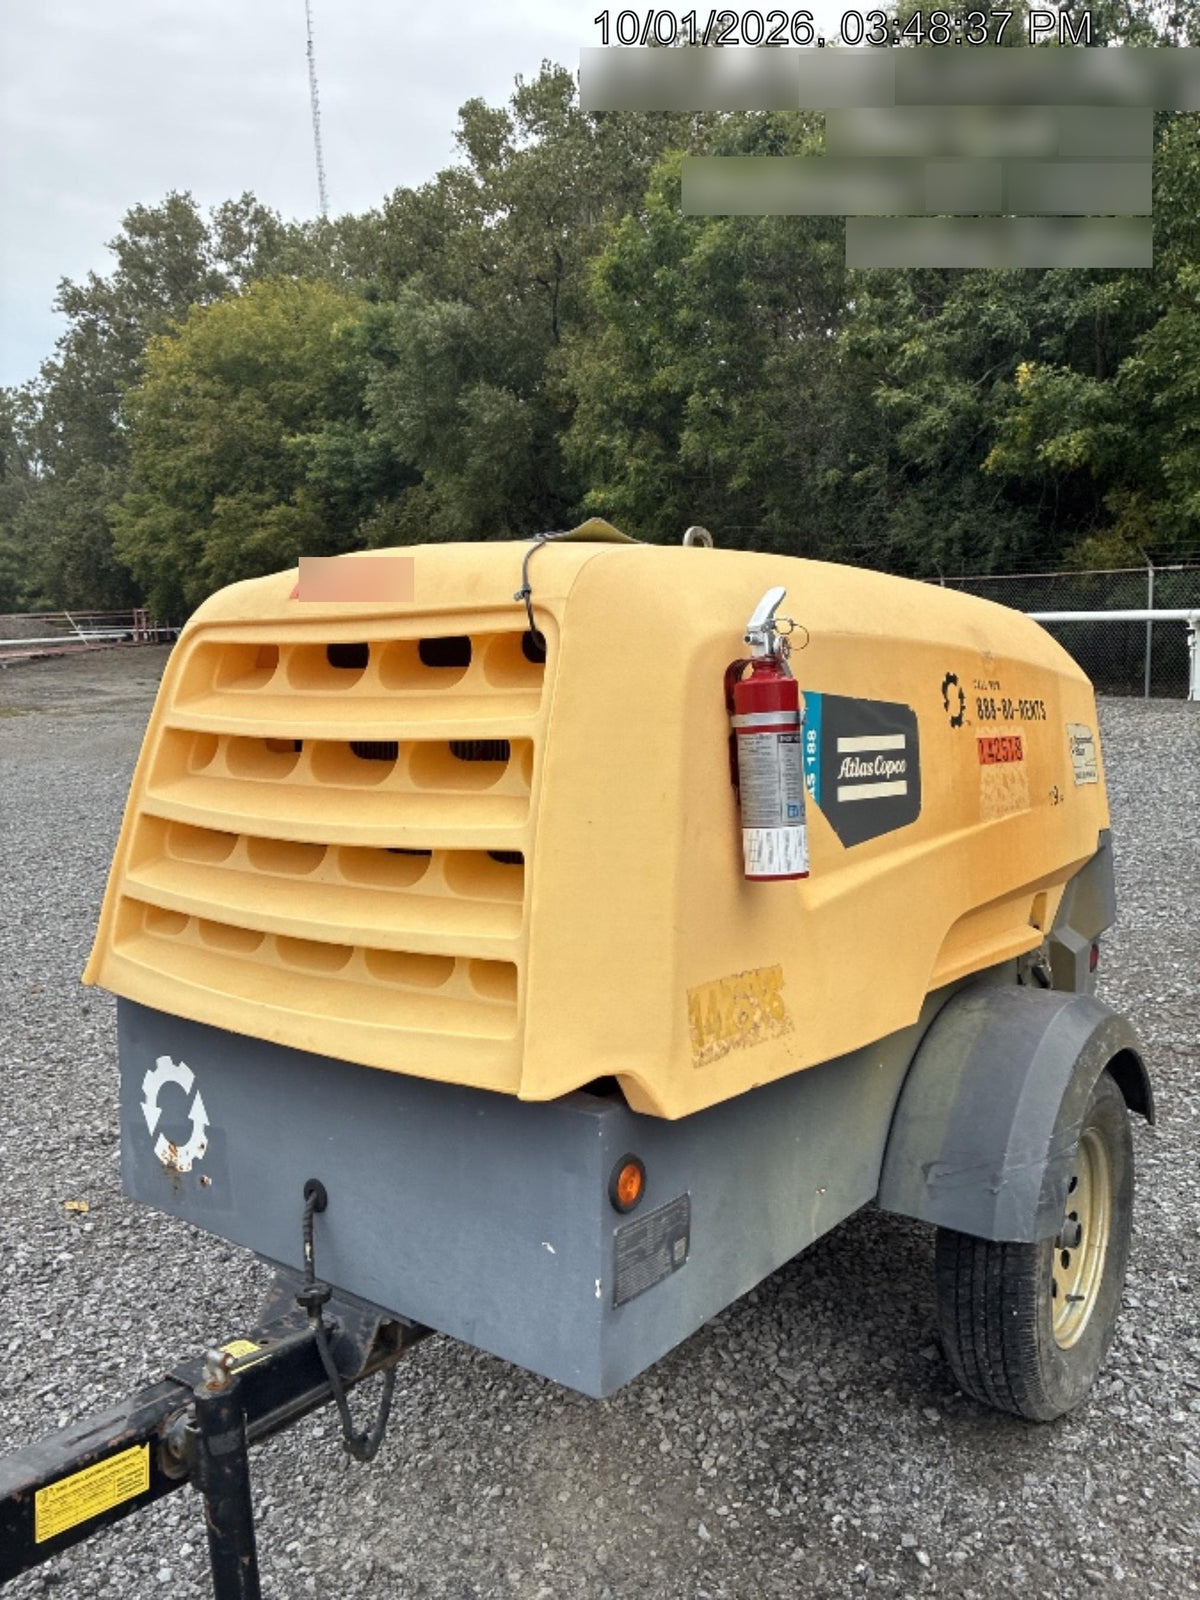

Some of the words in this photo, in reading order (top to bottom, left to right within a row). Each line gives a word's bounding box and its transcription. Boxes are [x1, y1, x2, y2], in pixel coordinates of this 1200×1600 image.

[806, 729, 817, 766] 188
[837, 757, 874, 779] Atlas
[874, 755, 907, 779] Copco
